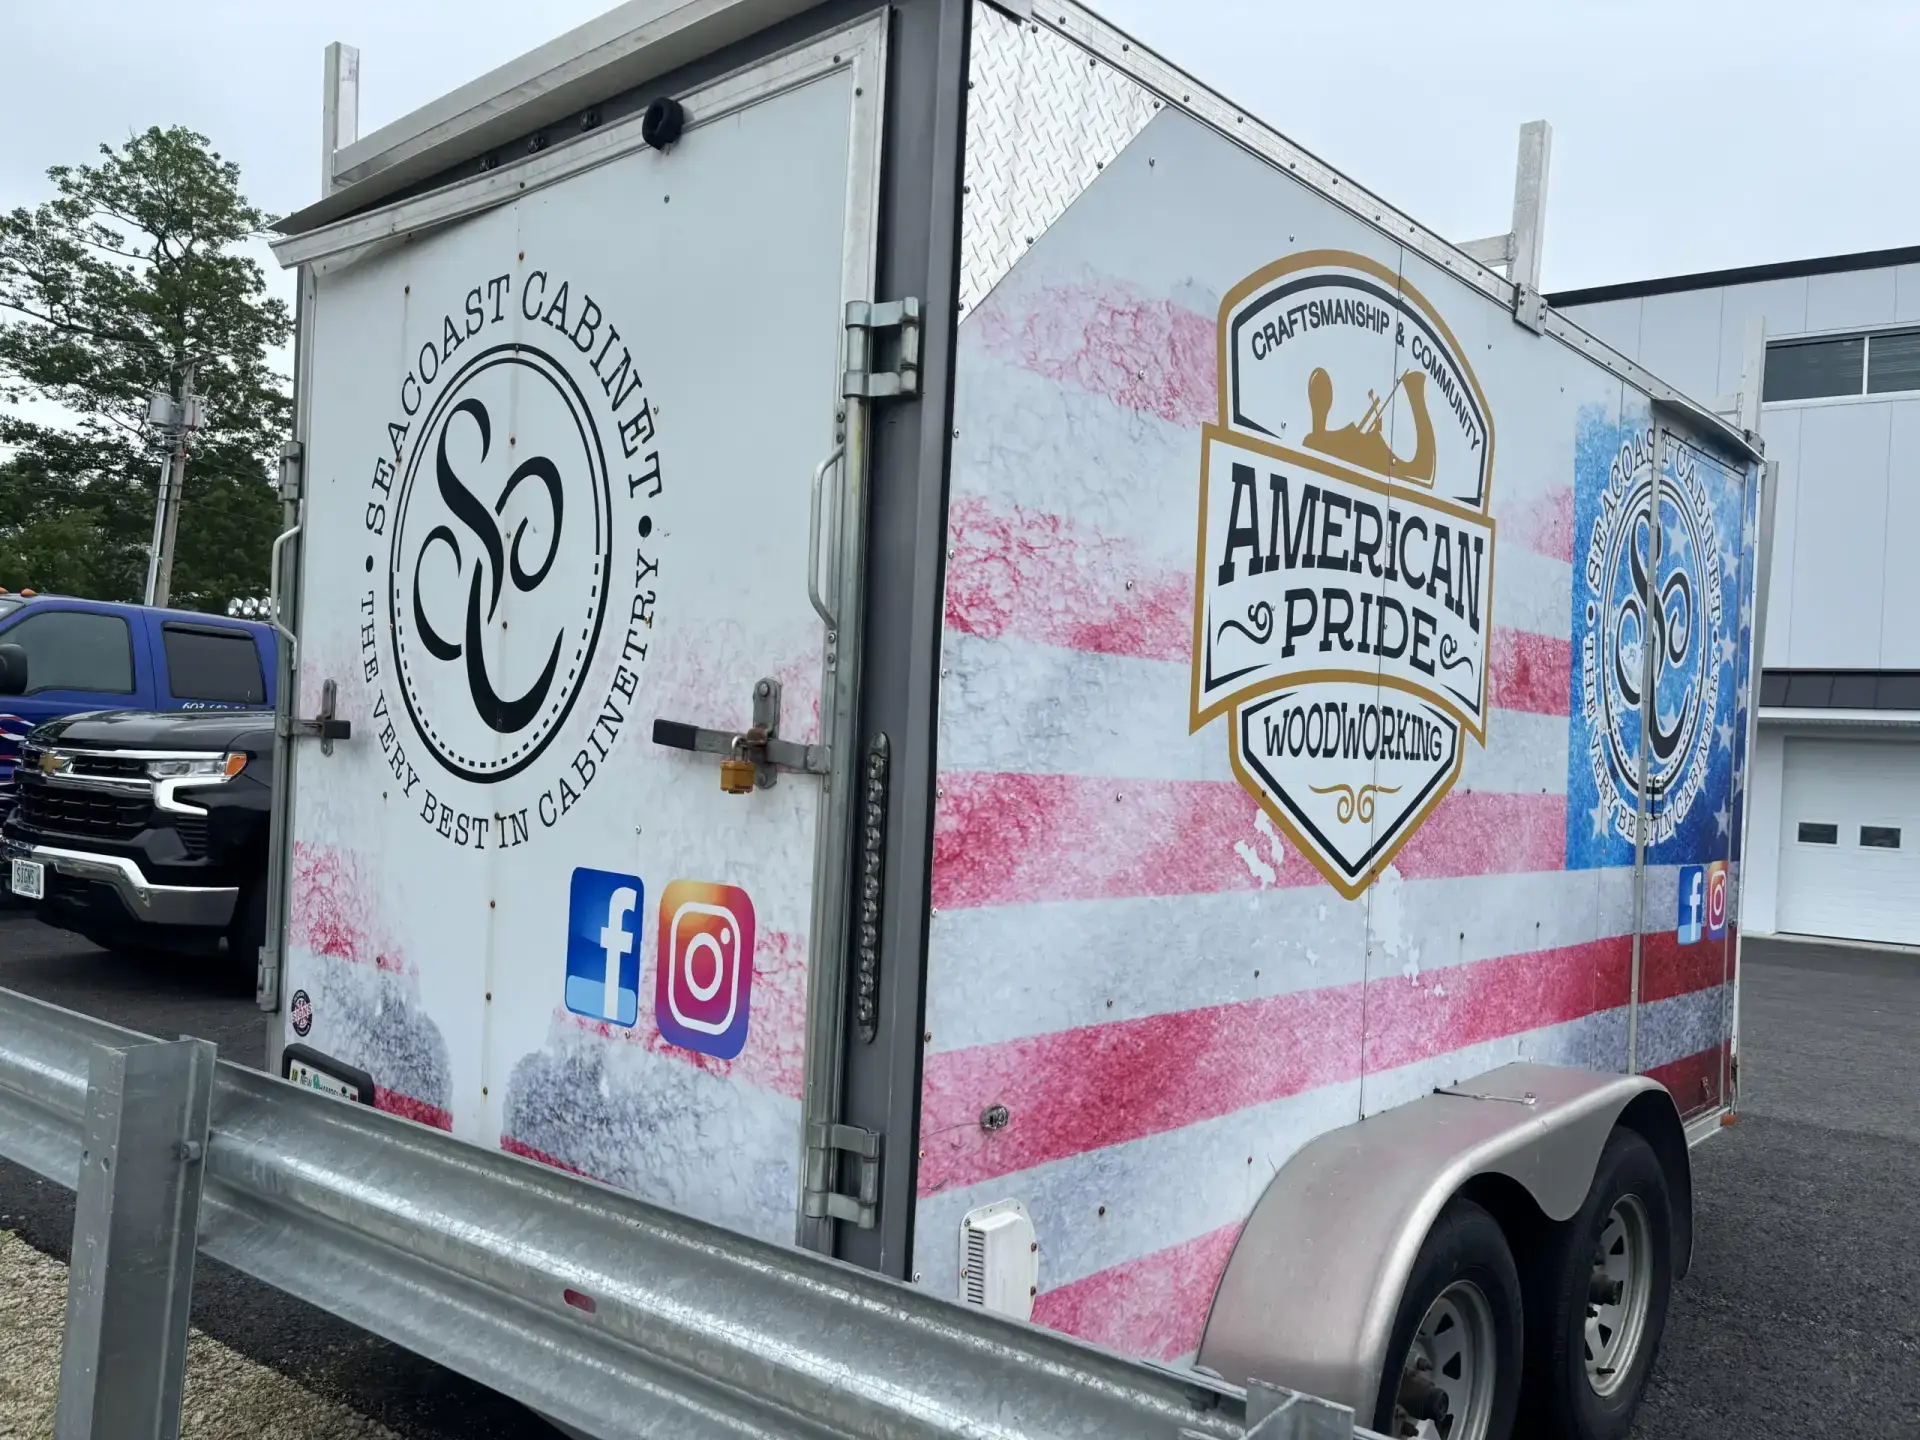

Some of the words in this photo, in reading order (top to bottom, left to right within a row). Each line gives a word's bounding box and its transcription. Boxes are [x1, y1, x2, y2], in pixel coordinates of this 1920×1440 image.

[366, 274, 510, 535] SEACOAST
[522, 270, 662, 498] CABINET
[1252, 299, 1390, 361] CRAFTSMANSHIP
[1395, 321, 1405, 348] &
[1412, 335, 1480, 451] COMMUNITY
[1218, 462, 1484, 635] AMERICAN
[1588, 427, 1671, 590] SEACOAST
[1677, 444, 1721, 621] CABINET
[361, 590, 379, 683] THE
[373, 689, 420, 797] VERY
[420, 789, 488, 849] BEST
[498, 808, 529, 849] IN
[538, 548, 658, 828] CABINETRY
[1281, 587, 1437, 677] PRIDE
[1264, 702, 1442, 762] WOODWORKING
[1584, 637, 1596, 719] THE
[1592, 724, 1618, 815] VERY
[1659, 808, 1673, 838] IN
[1676, 649, 1720, 820] CABINETRY
[17, 866, 35, 885] SIGNS
